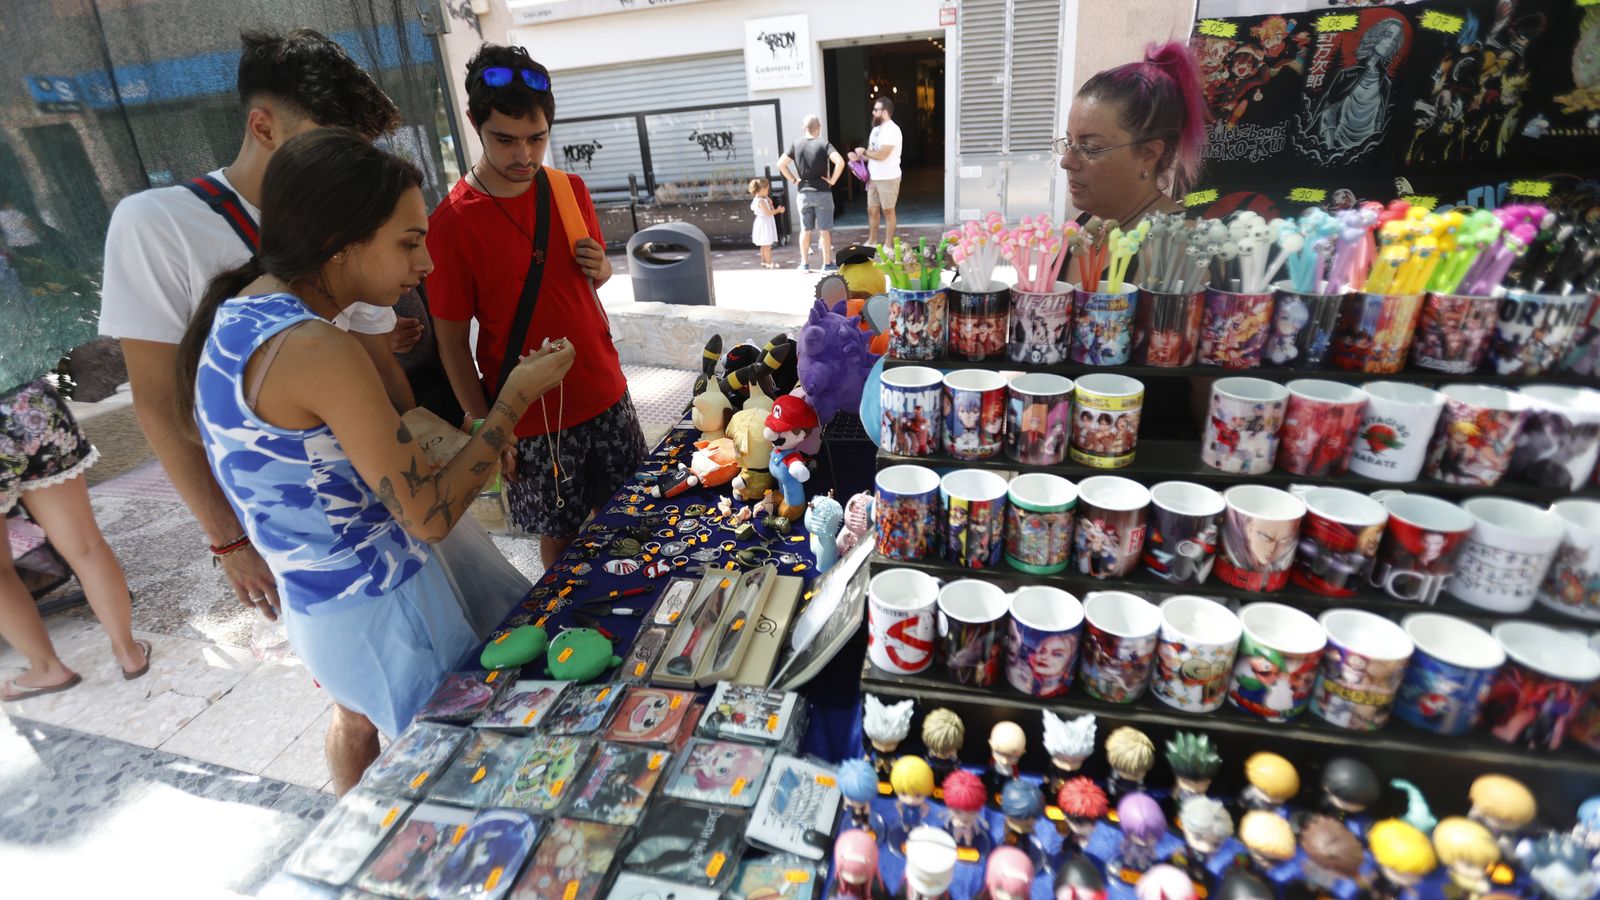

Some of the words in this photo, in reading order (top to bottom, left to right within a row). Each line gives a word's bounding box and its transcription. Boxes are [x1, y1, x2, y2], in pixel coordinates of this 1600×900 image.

[1210, 23, 1224, 32] 05
[1327, 18, 1342, 28] 06
[1194, 193, 1206, 202] 09
